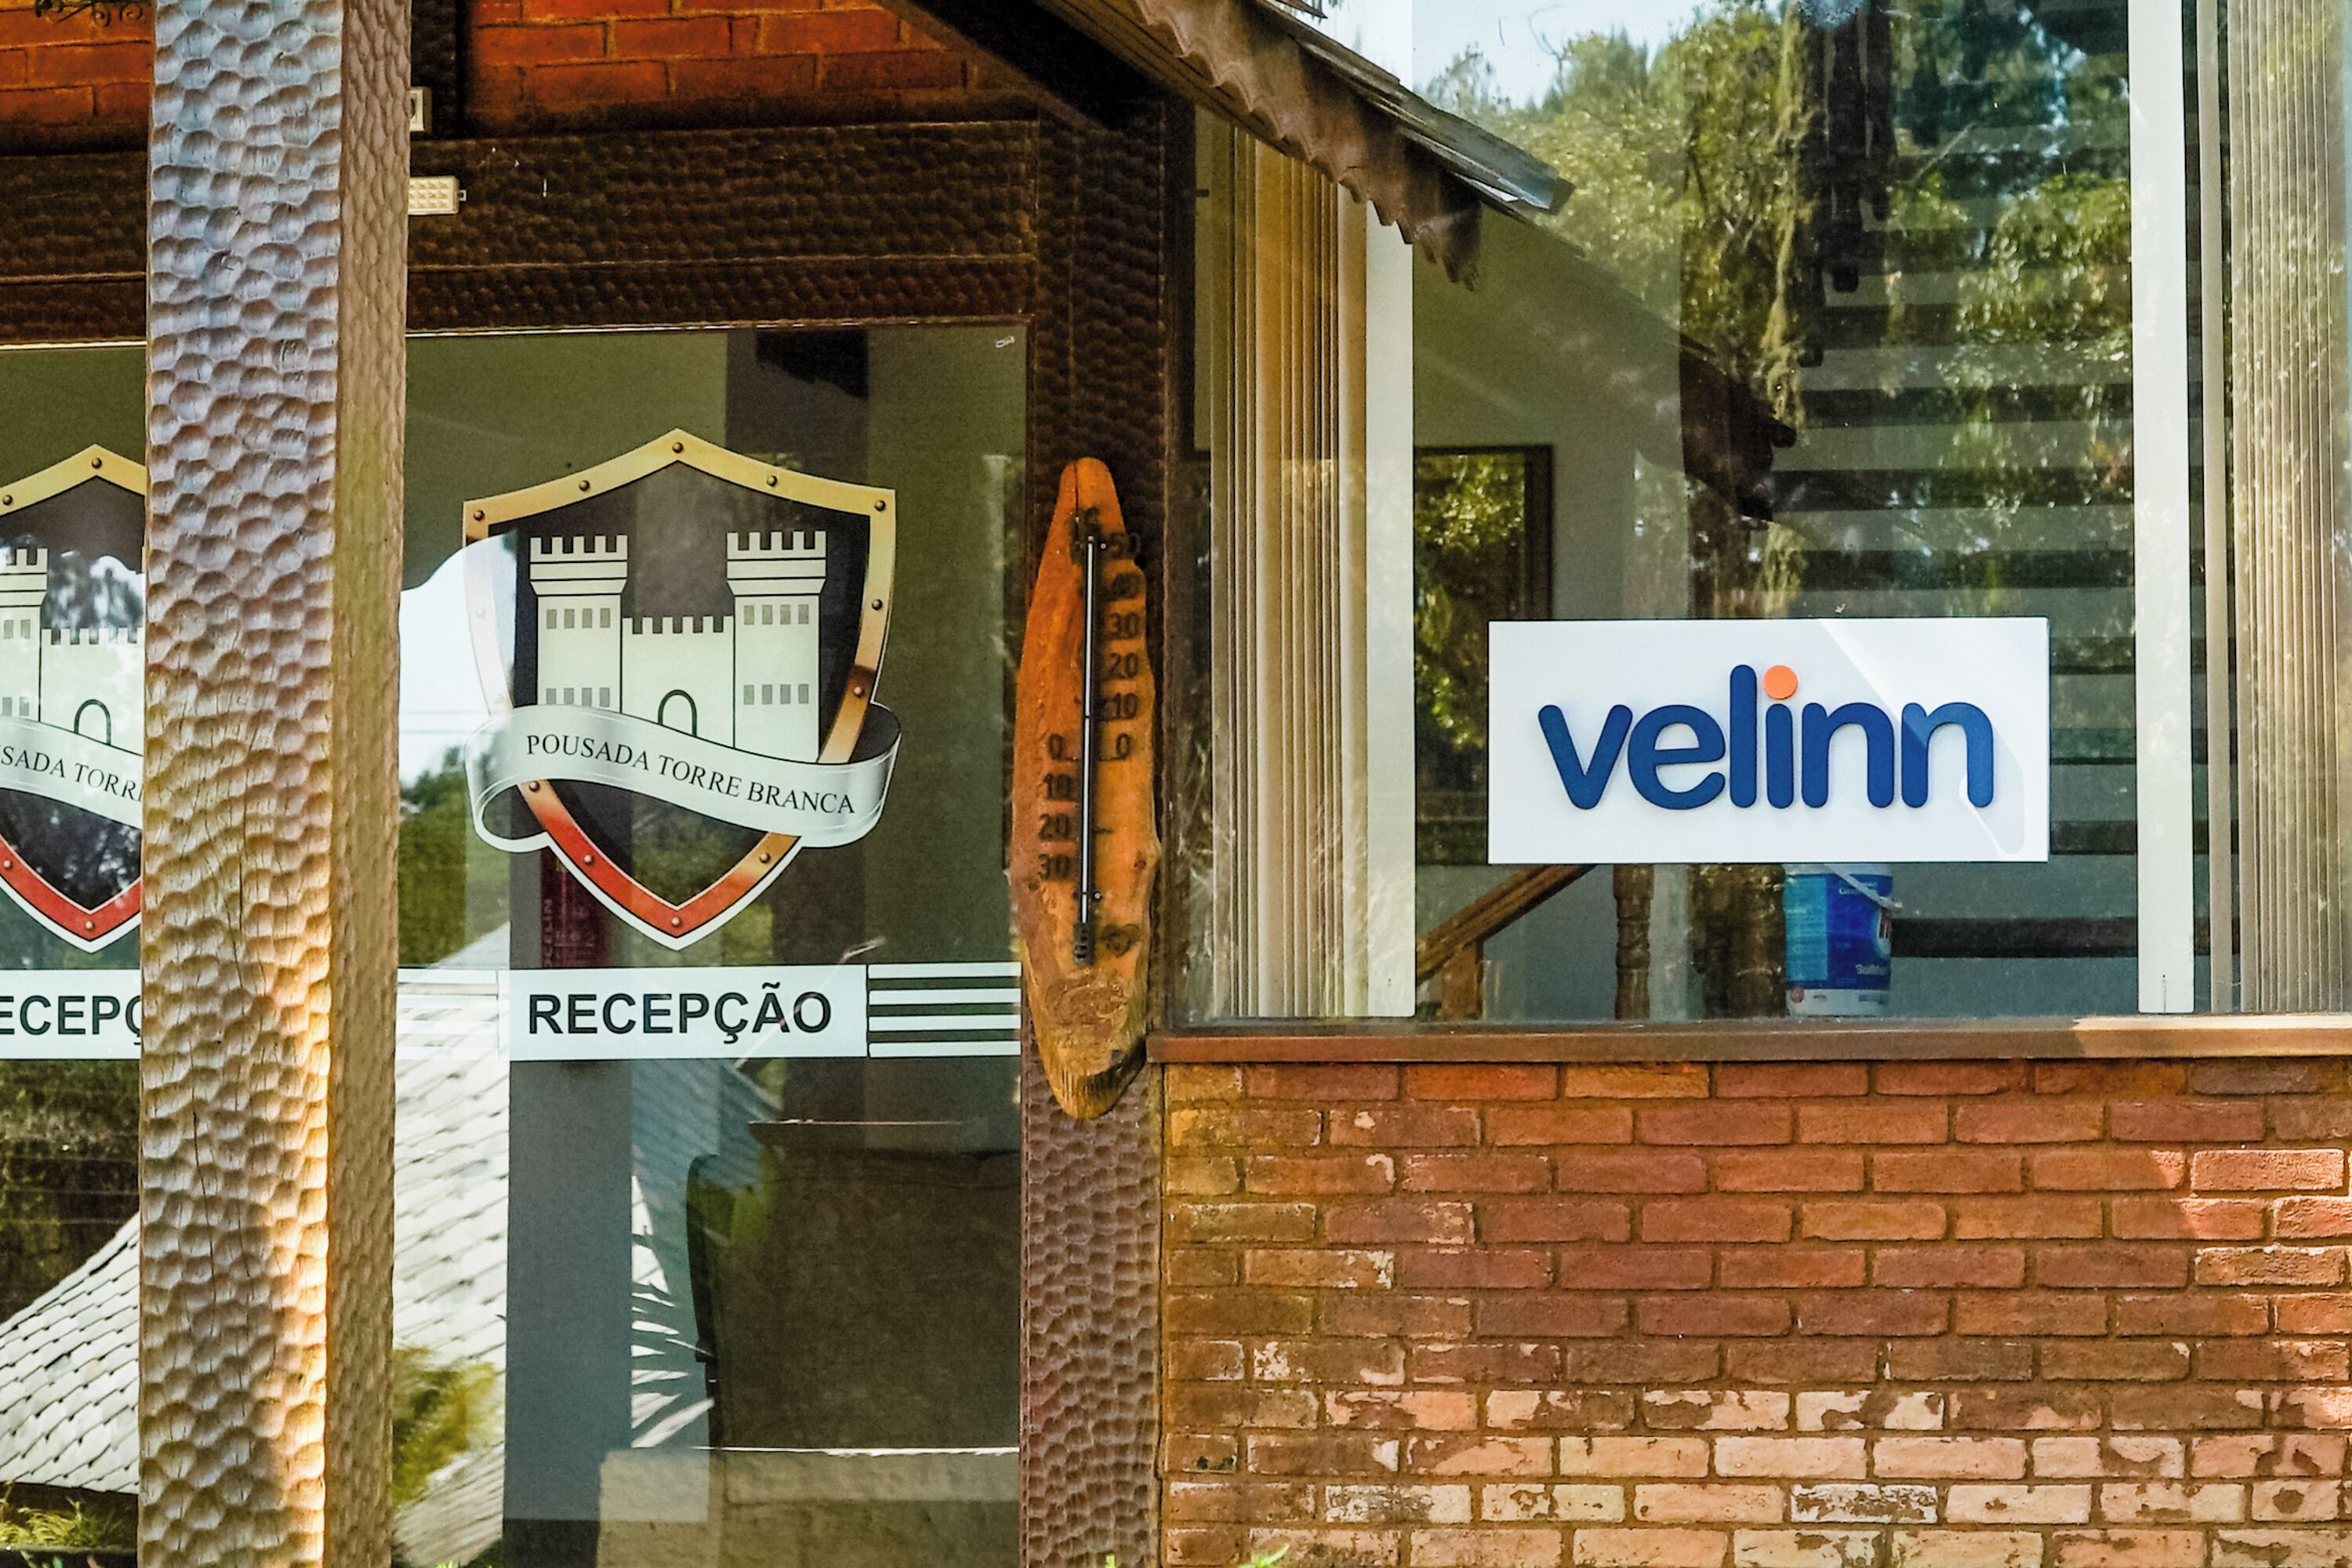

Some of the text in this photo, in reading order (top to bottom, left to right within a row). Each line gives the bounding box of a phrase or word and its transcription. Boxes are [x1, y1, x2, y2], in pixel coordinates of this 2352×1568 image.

[1108, 612, 1140, 639] 30
[1108, 652, 1139, 679] 20
[1113, 692, 1139, 719] 10
[1047, 732, 1064, 760] 0
[1116, 732, 1131, 759] 0
[1537, 664, 1994, 811] velinn
[526, 733, 855, 814] POUSADA TORRE BRANCA
[1043, 773, 1071, 800] 10
[1038, 813, 1069, 840] 20
[1037, 854, 1070, 880] 30
[528, 981, 832, 1044] RECEPÇÃO
